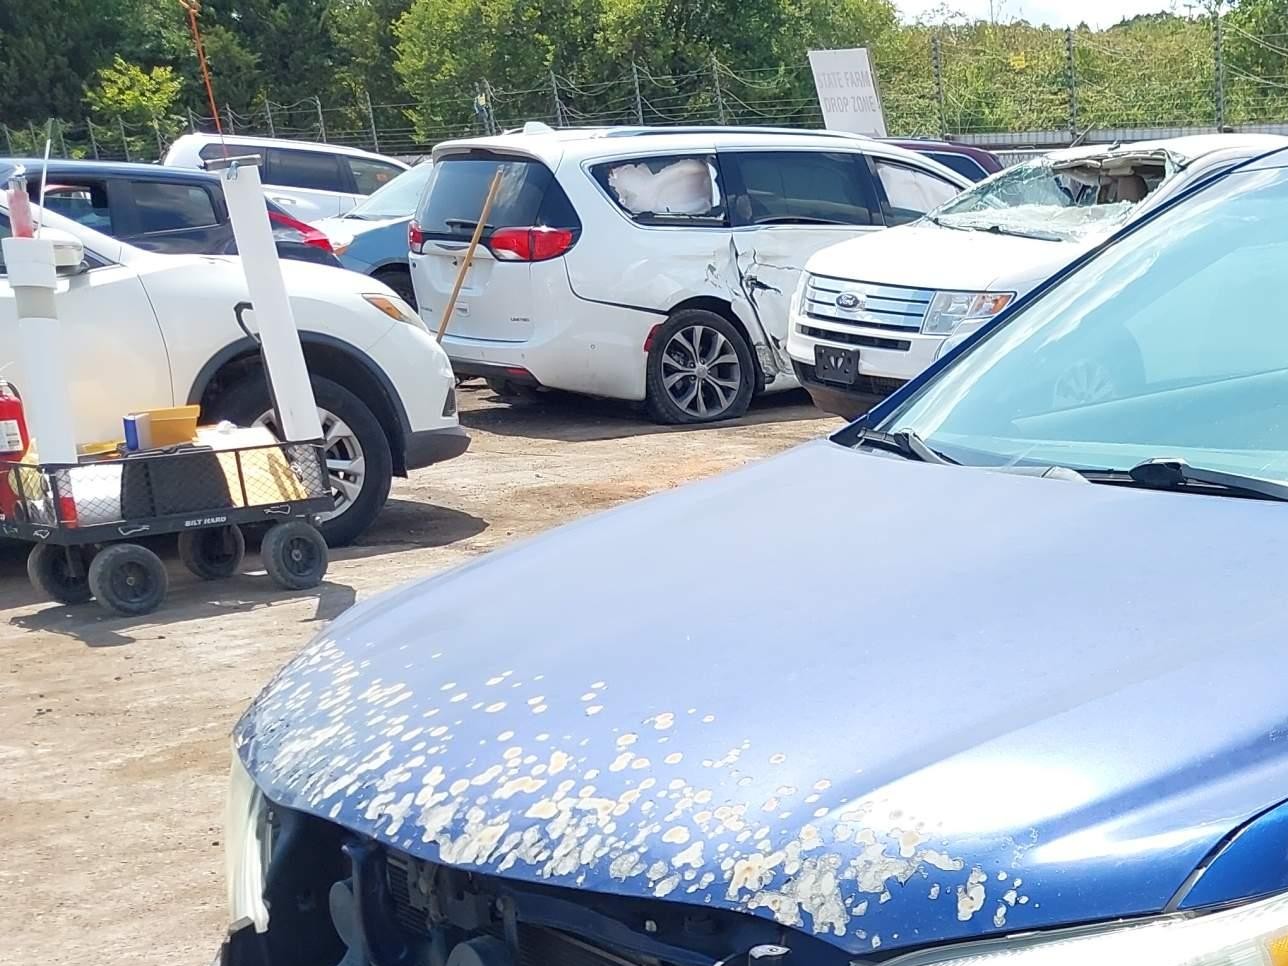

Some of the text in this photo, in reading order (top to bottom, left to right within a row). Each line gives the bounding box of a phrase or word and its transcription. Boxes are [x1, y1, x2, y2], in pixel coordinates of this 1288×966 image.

[816, 70, 871, 88] STATE FARM
[823, 95, 877, 112] DROP ZONE
[185, 519, 202, 527] BILT
